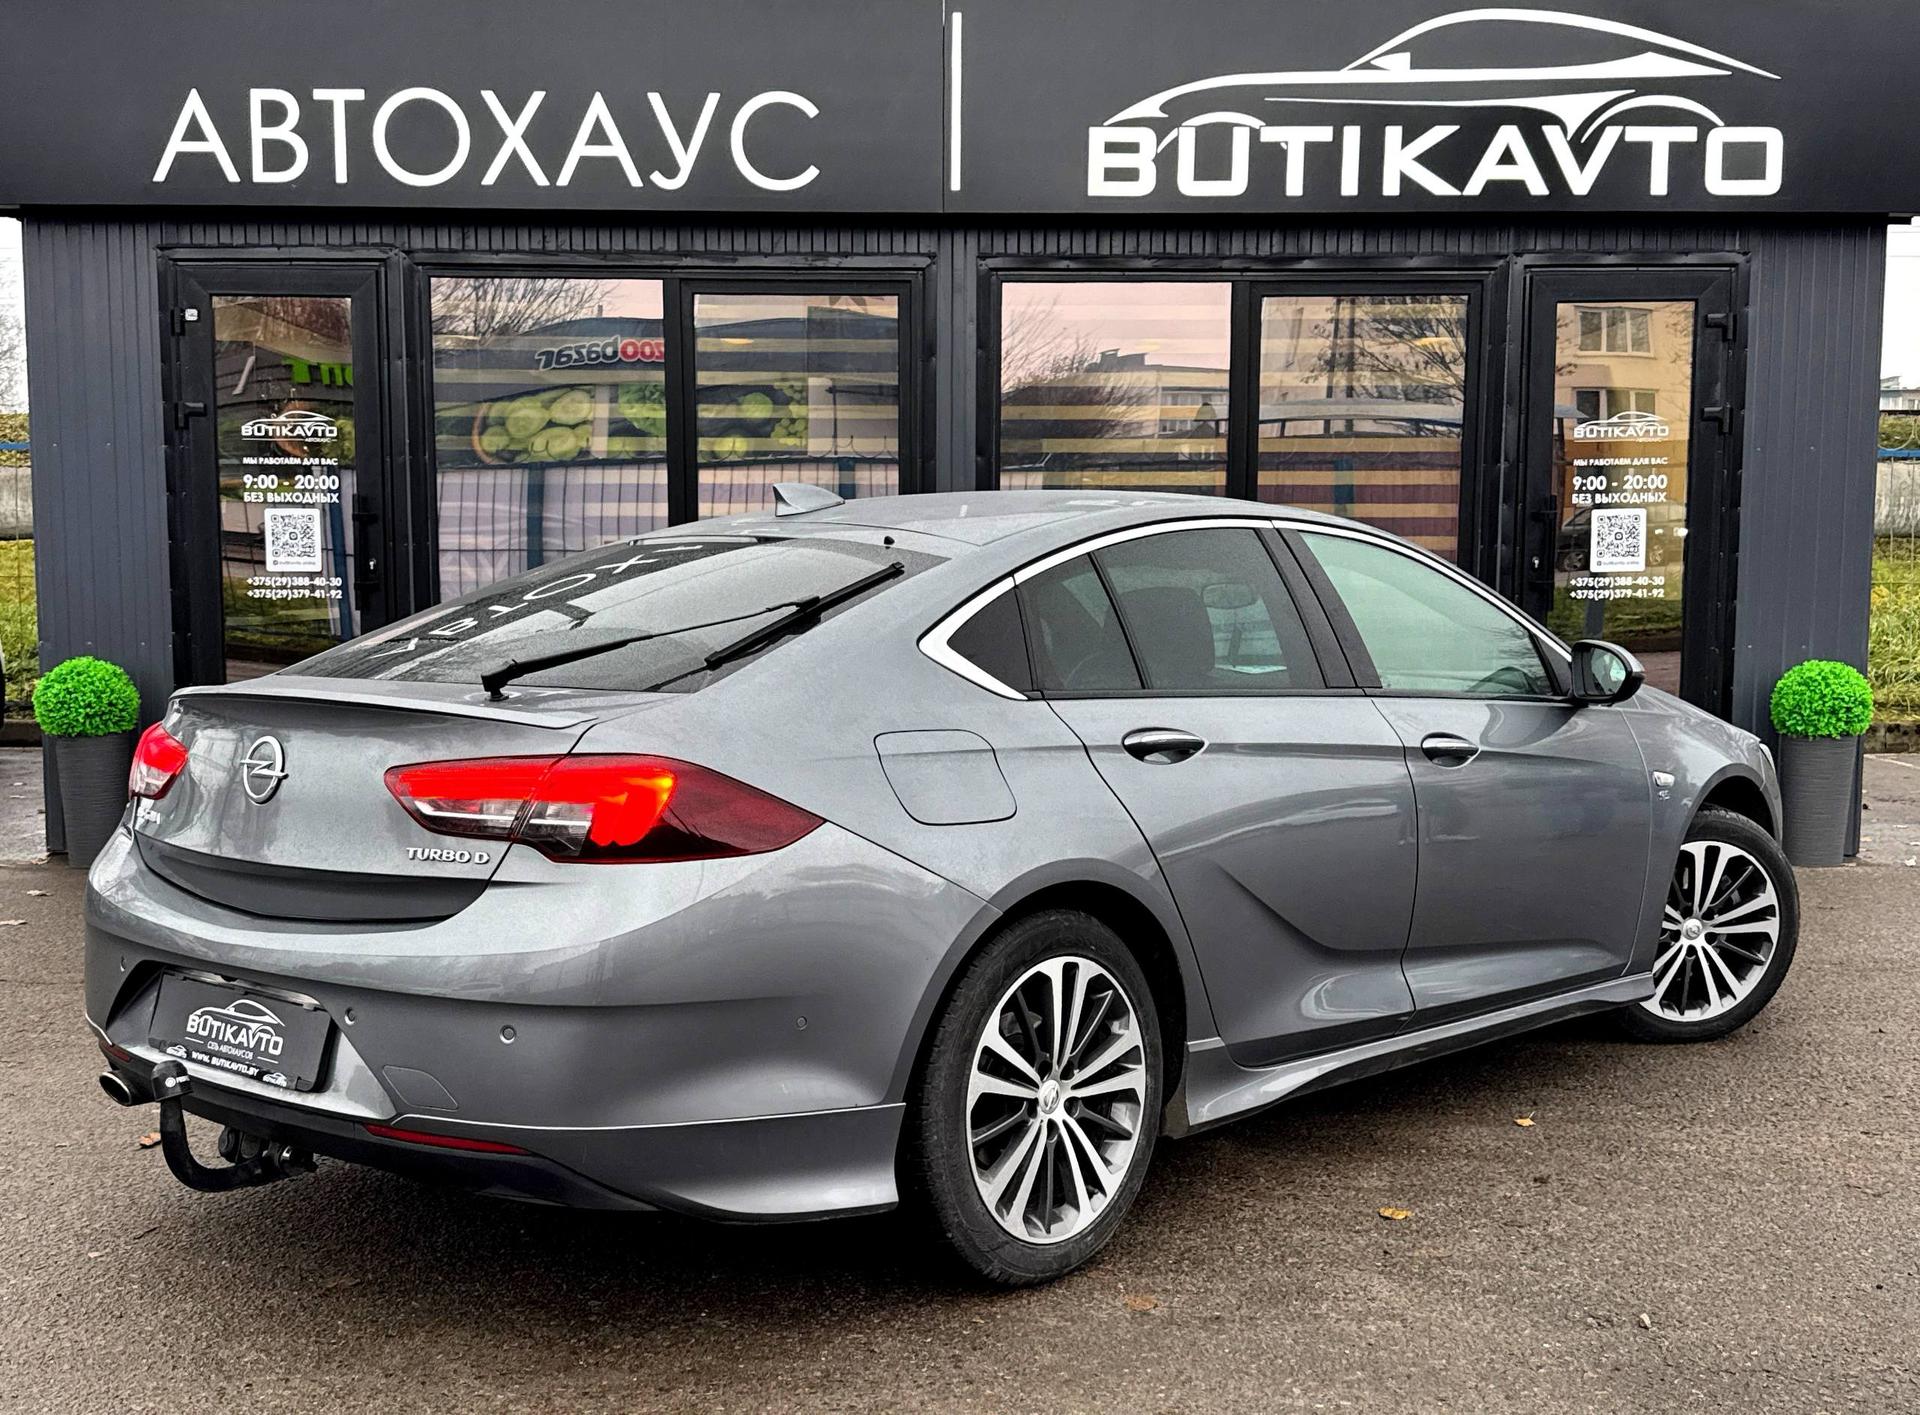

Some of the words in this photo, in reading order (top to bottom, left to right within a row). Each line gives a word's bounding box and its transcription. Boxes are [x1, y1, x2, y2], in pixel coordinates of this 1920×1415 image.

[152, 87, 820, 191] АВТОХАУС
[1088, 125, 1784, 197] BUTIKAVTO
[241, 425, 338, 437] BUTIKAVTO
[1573, 426, 1670, 438] BUTIKAVTO
[243, 457, 258, 465] МЫ
[259, 457, 301, 465] РАБОТАЕМ
[302, 458, 320, 466] ДЛЯ
[321, 458, 338, 466] ВАС
[1573, 459, 1588, 467] МЫ
[1589, 458, 1632, 466] РАБОТАЕМ
[1632, 457, 1650, 466] ДЛЯ
[1651, 457, 1669, 465] ВАС
[243, 474, 279, 489] 9:00
[294, 475, 340, 490] 20:00
[1572, 476, 1607, 491] 9:00
[1622, 474, 1668, 490] 20:00
[243, 492, 264, 502] БЕЗ
[266, 492, 340, 504] ВЫХОДНЫХ
[1571, 494, 1593, 505] БЕЗ
[1594, 492, 1667, 504] ВЫХОДНЫХ
[246, 576, 343, 588] +375(29)388-40-30
[1569, 576, 1665, 589] +375(29)388-40-30
[246, 589, 343, 601] +375(29)379-41-92
[1569, 588, 1665, 601] +375(29)379-41-92
[406, 847, 471, 864] TURBO
[474, 852, 490, 864] D
[186, 1013, 284, 1056] BUTIKAVTO
[210, 1056, 260, 1077] BUTIKAVTO.BY
